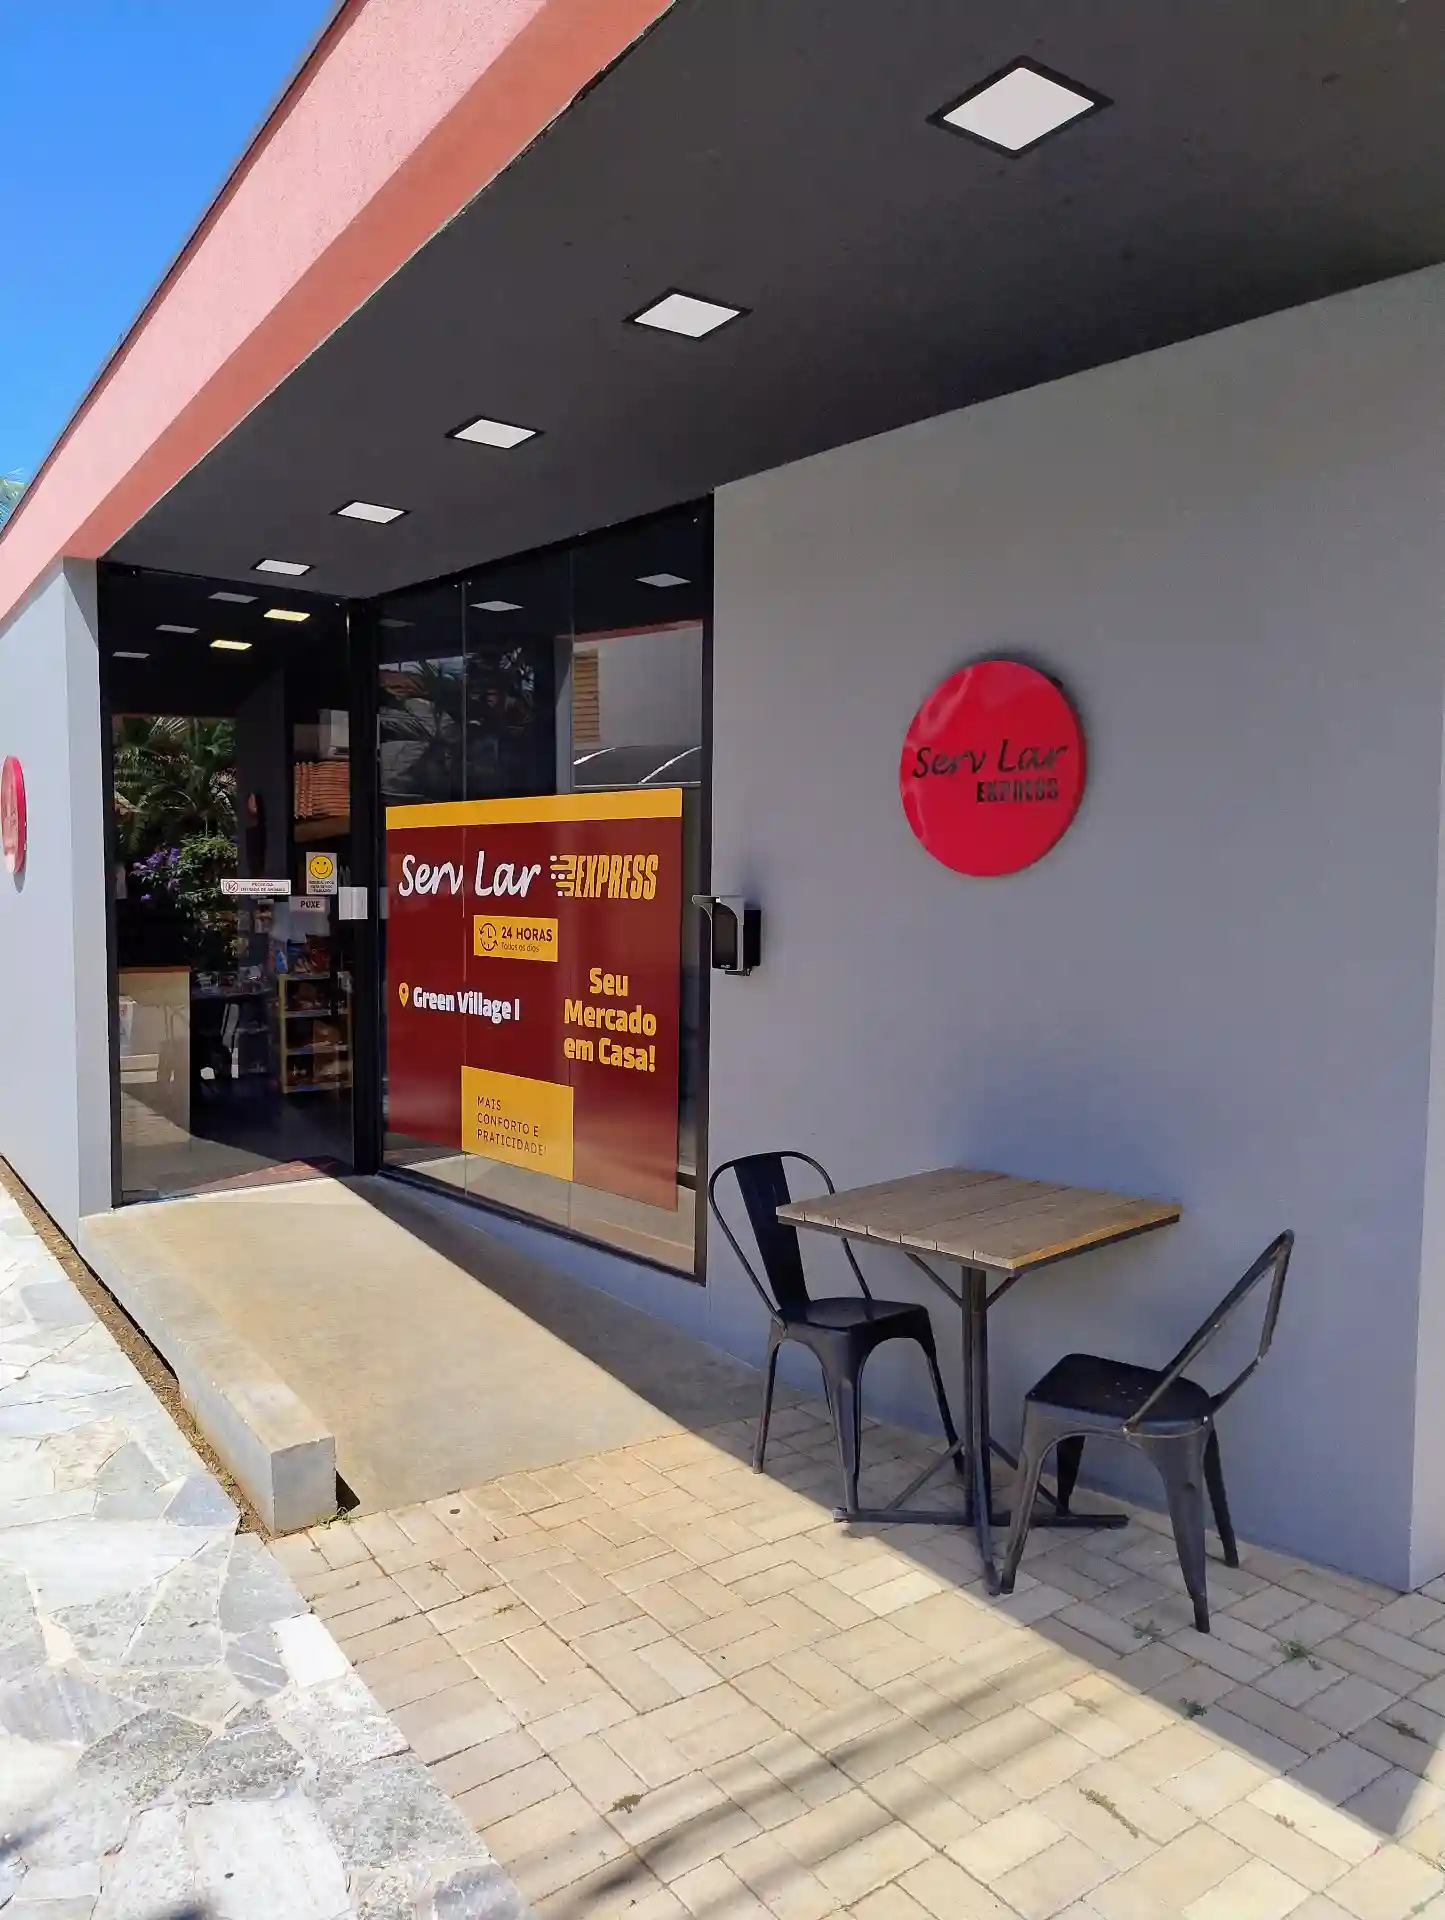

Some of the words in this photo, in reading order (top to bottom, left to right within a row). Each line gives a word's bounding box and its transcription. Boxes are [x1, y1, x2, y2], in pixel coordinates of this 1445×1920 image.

[913, 746, 986, 778] Serv
[998, 739, 1068, 772] Lar
[399, 854, 464, 897] Serv
[475, 851, 542, 897] Lar
[575, 854, 659, 899] EXPRESS
[300, 900, 321, 909] PUXE
[501, 926, 513, 939] 24
[516, 927, 553, 942] HORAS
[589, 967, 629, 997] Seu
[413, 986, 455, 1012] Green
[456, 990, 512, 1024] Village
[563, 998, 657, 1036] Mercado
[563, 1037, 594, 1062] em
[598, 1037, 656, 1073] Casa!
[477, 1095, 502, 1111] MAIS
[477, 1112, 530, 1135] CONFORTO
[533, 1125, 540, 1138] E
[477, 1128, 547, 1156] PRATICIDADE!
